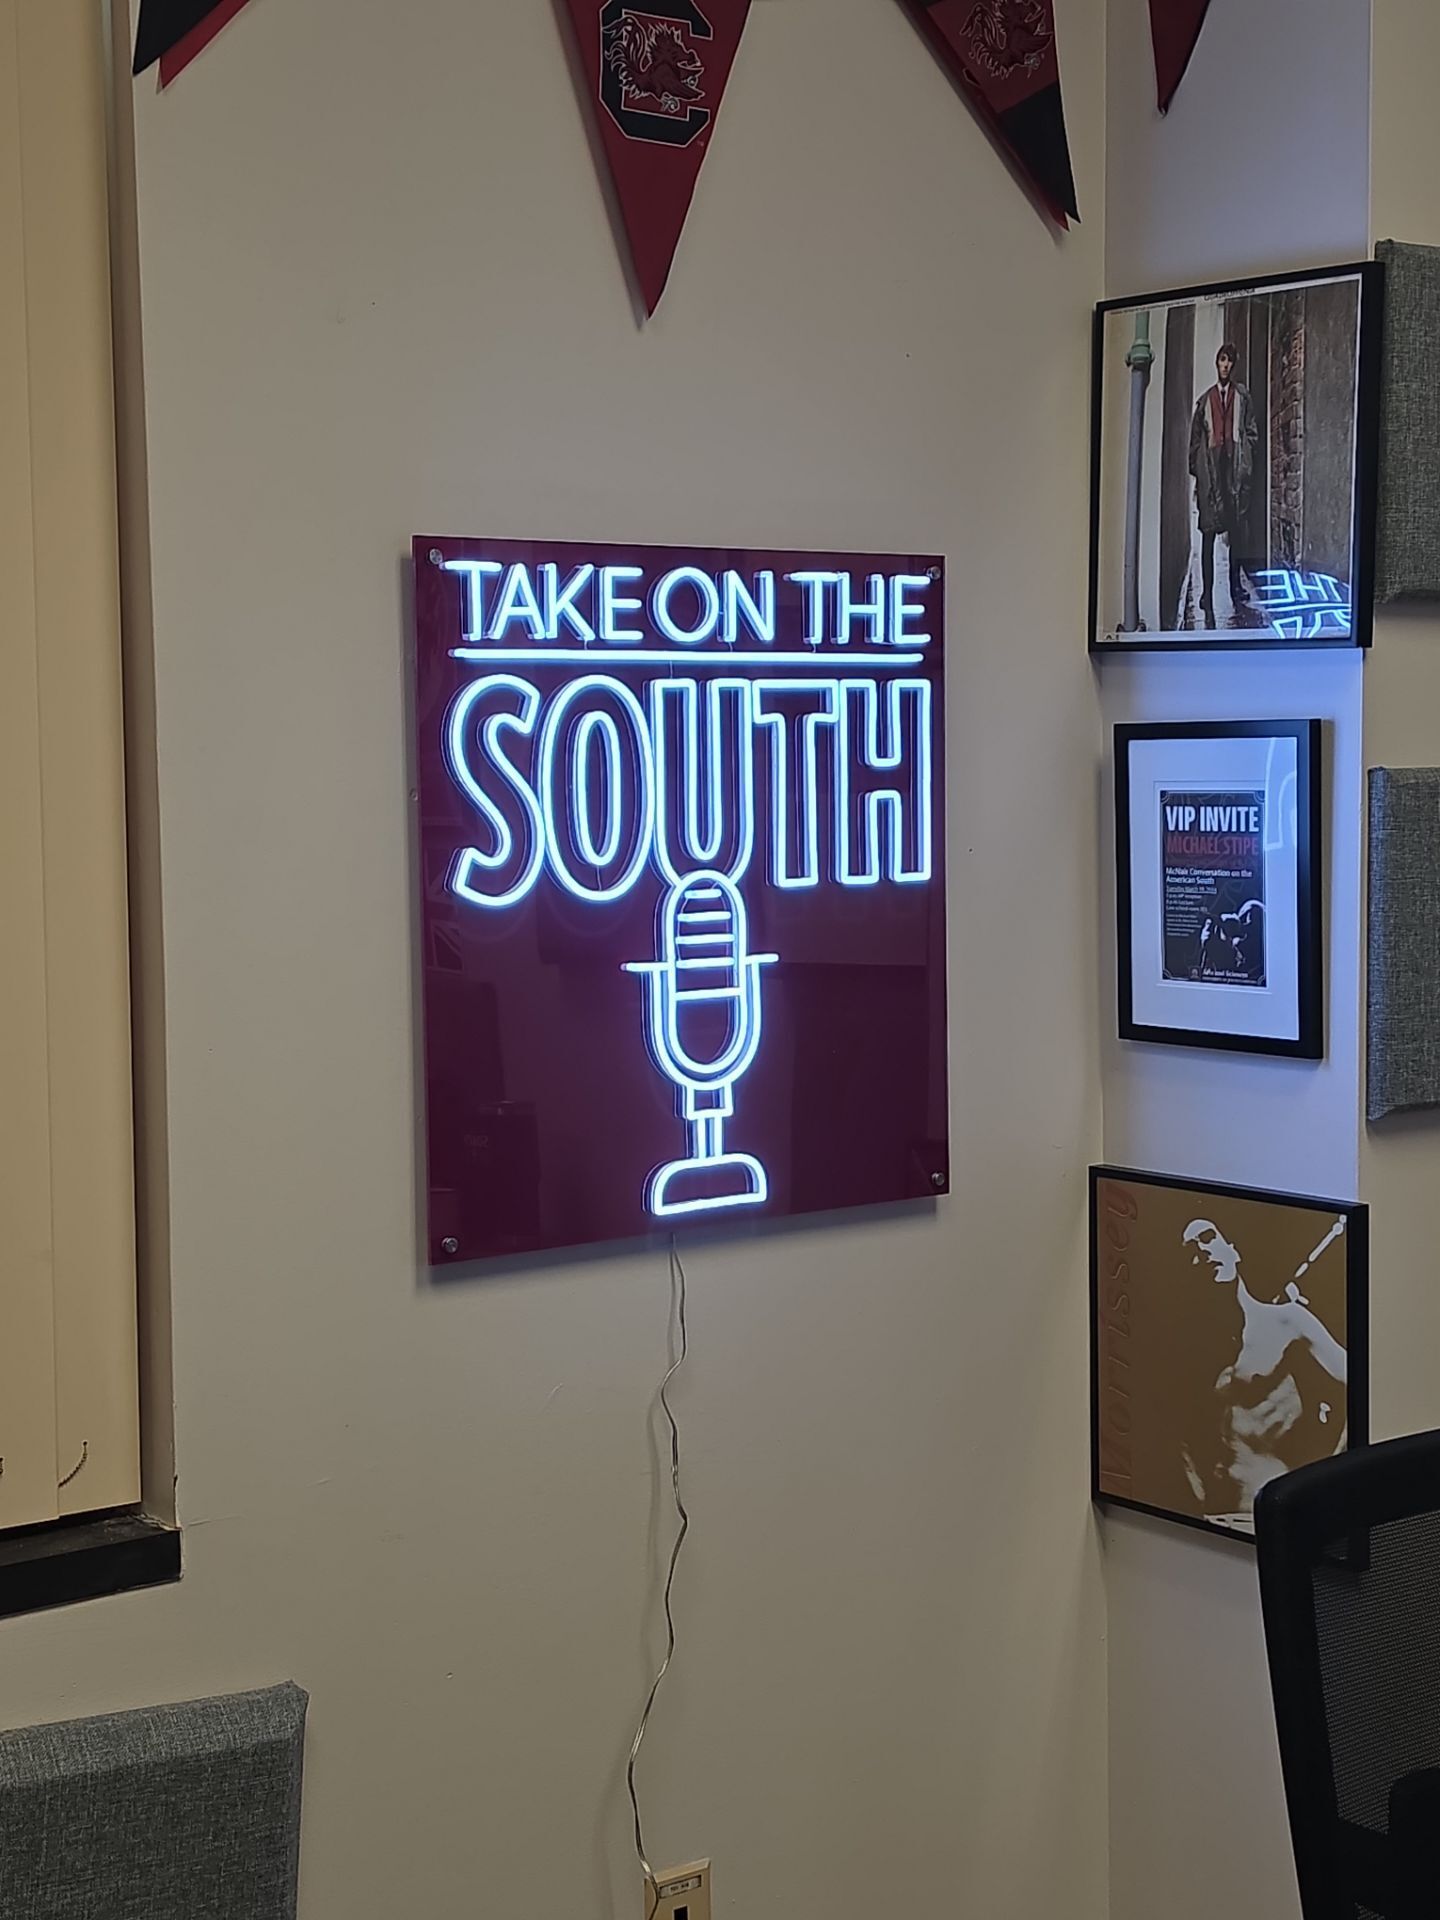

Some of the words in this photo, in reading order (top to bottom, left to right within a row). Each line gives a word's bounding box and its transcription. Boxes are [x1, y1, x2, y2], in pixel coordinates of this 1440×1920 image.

[442, 561, 643, 640] TAKE
[650, 566, 774, 642] ON
[785, 571, 931, 644] THE
[444, 673, 931, 907] SOUTH
[1165, 805, 1196, 831] VIP
[1199, 805, 1260, 832] INVITE
[1167, 835, 1220, 854] MICHAEL
[1223, 836, 1260, 856] STIPE
[1166, 875, 1196, 884] American
[1189, 868, 1231, 877] Conversation
[1241, 870, 1253, 878] the
